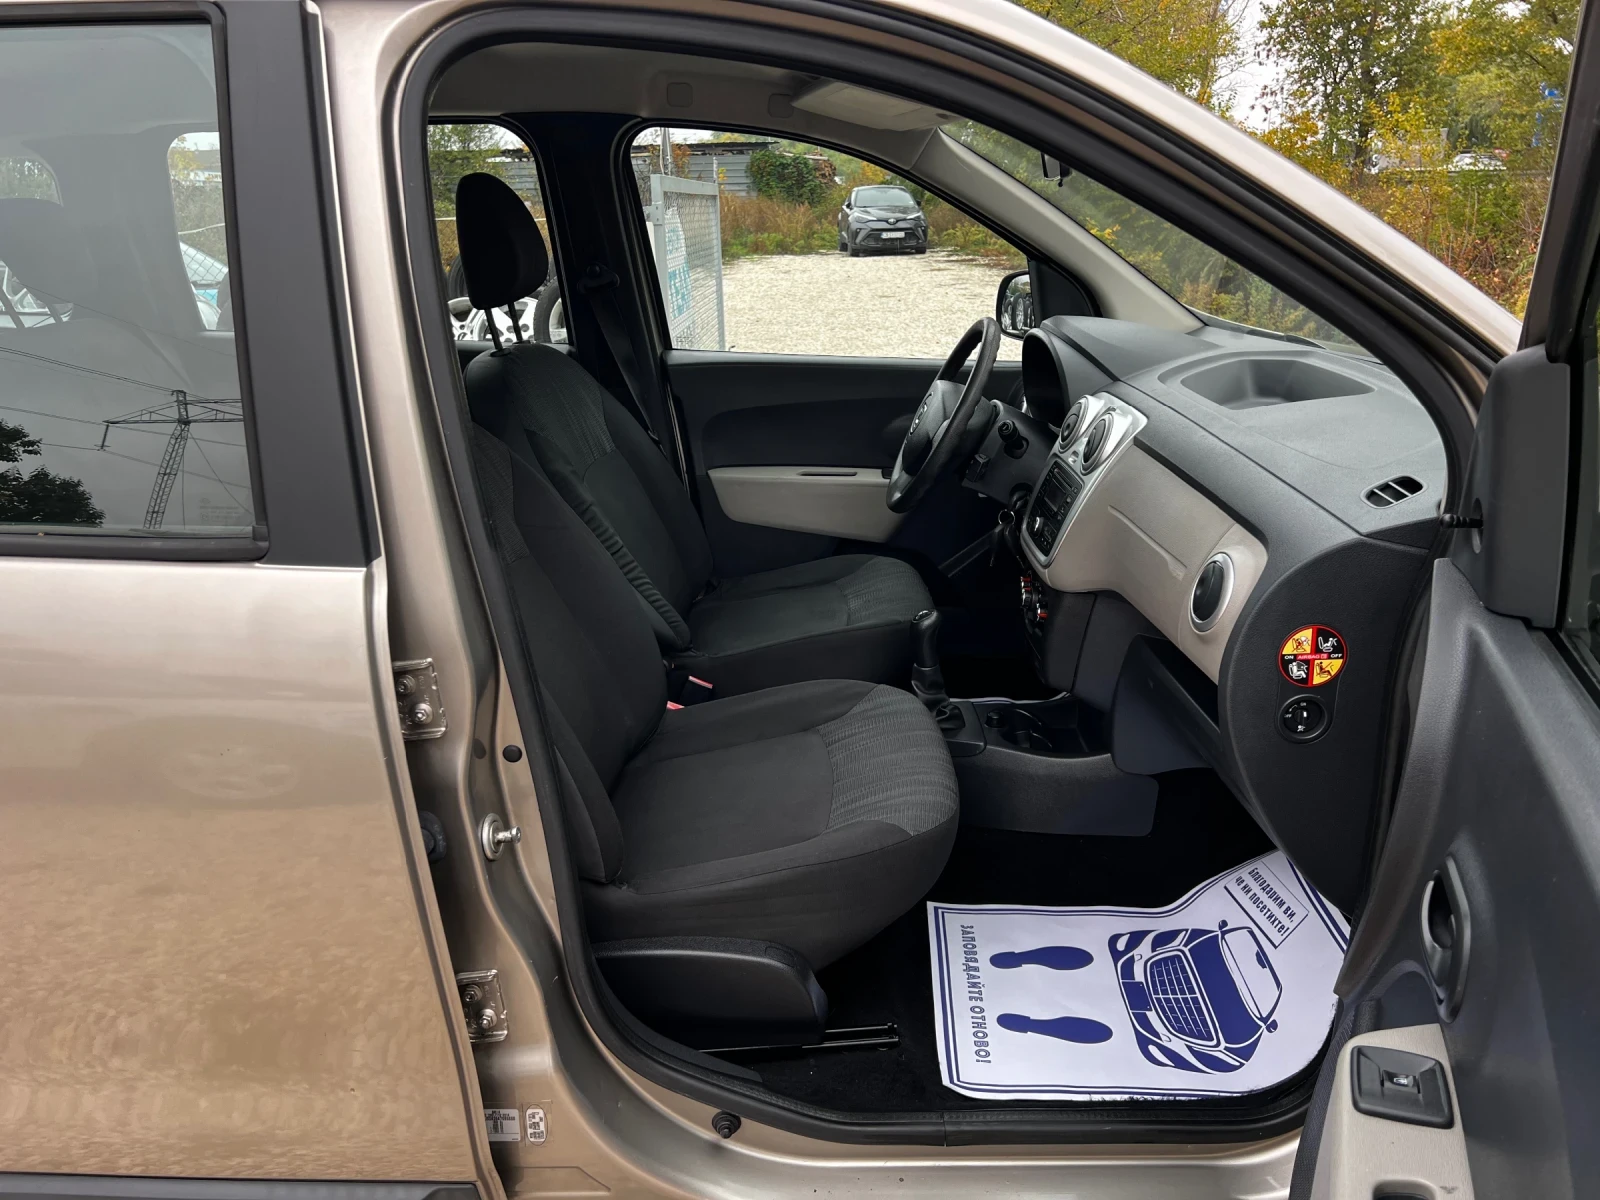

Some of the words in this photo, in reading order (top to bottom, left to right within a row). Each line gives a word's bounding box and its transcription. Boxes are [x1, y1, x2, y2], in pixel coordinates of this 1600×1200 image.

[1235, 876, 1245, 887] че
[1240, 883, 1253, 896] ни
[1248, 892, 1290, 936] посетихте!
[960, 924, 985, 1002] ЗАПОВЯДАЙТЕ
[970, 1005, 991, 1064] ОТНОВО!
